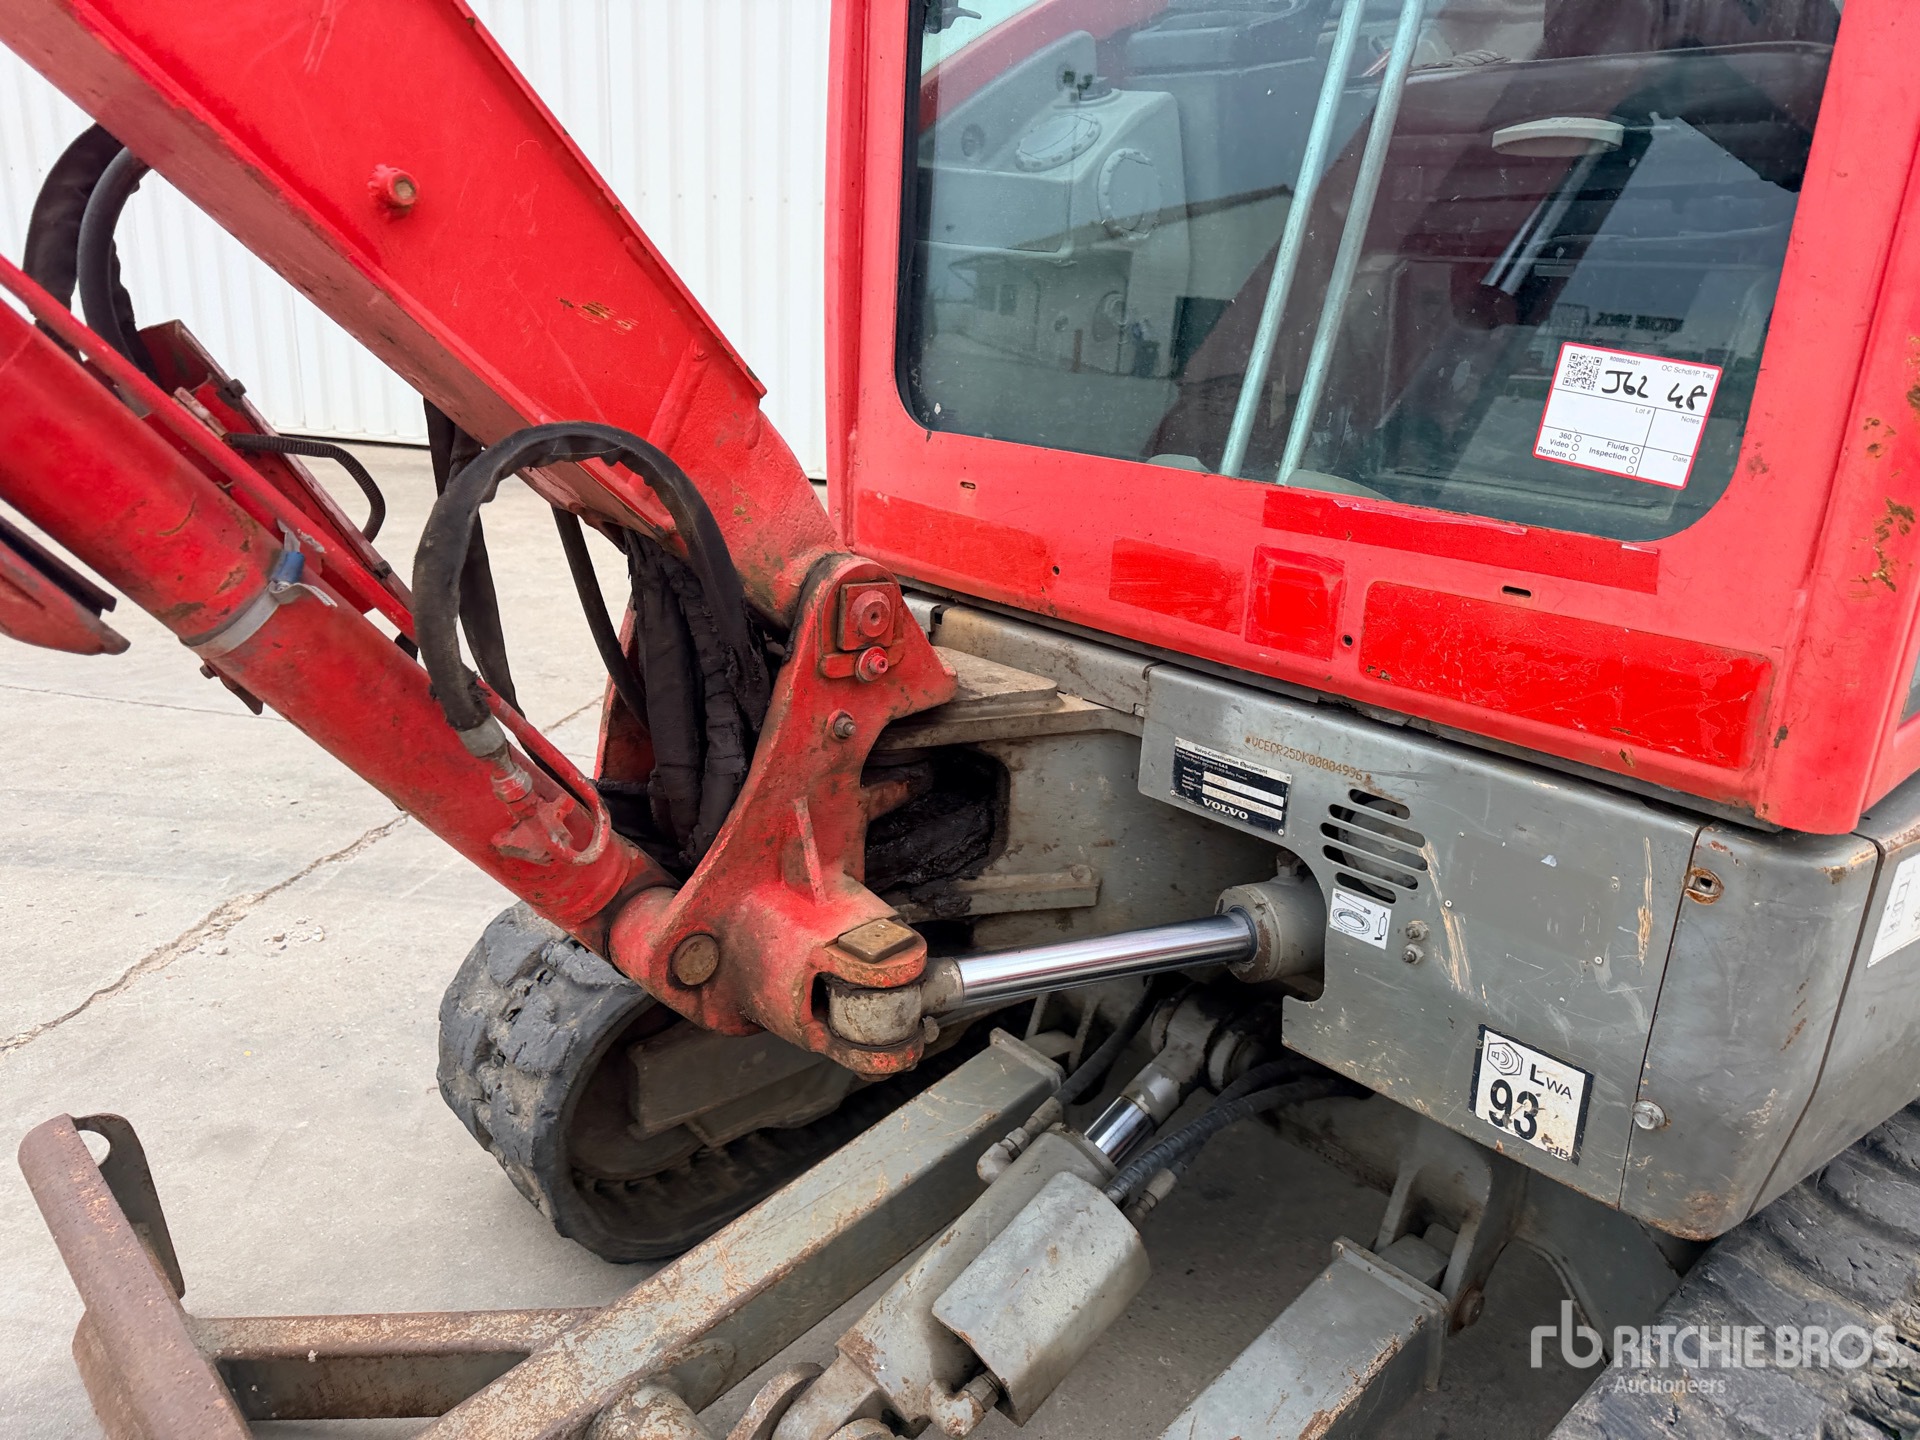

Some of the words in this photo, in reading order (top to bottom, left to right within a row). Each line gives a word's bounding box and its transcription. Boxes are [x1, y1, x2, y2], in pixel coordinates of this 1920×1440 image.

[1661, 364, 1673, 372] OC
[1702, 371, 1715, 380] Tag
[1681, 415, 1700, 425] Notes
[1559, 432, 1572, 440] 360
[1550, 438, 1569, 449] Video
[1607, 441, 1629, 452] Fluids
[1538, 446, 1567, 459] Rephoto
[1589, 447, 1627, 461] Inspection
[1672, 455, 1688, 463] Date
[1202, 797, 1249, 820] VOLVO
[1489, 1079, 1539, 1140] 93
[1549, 1146, 1570, 1159] dB
